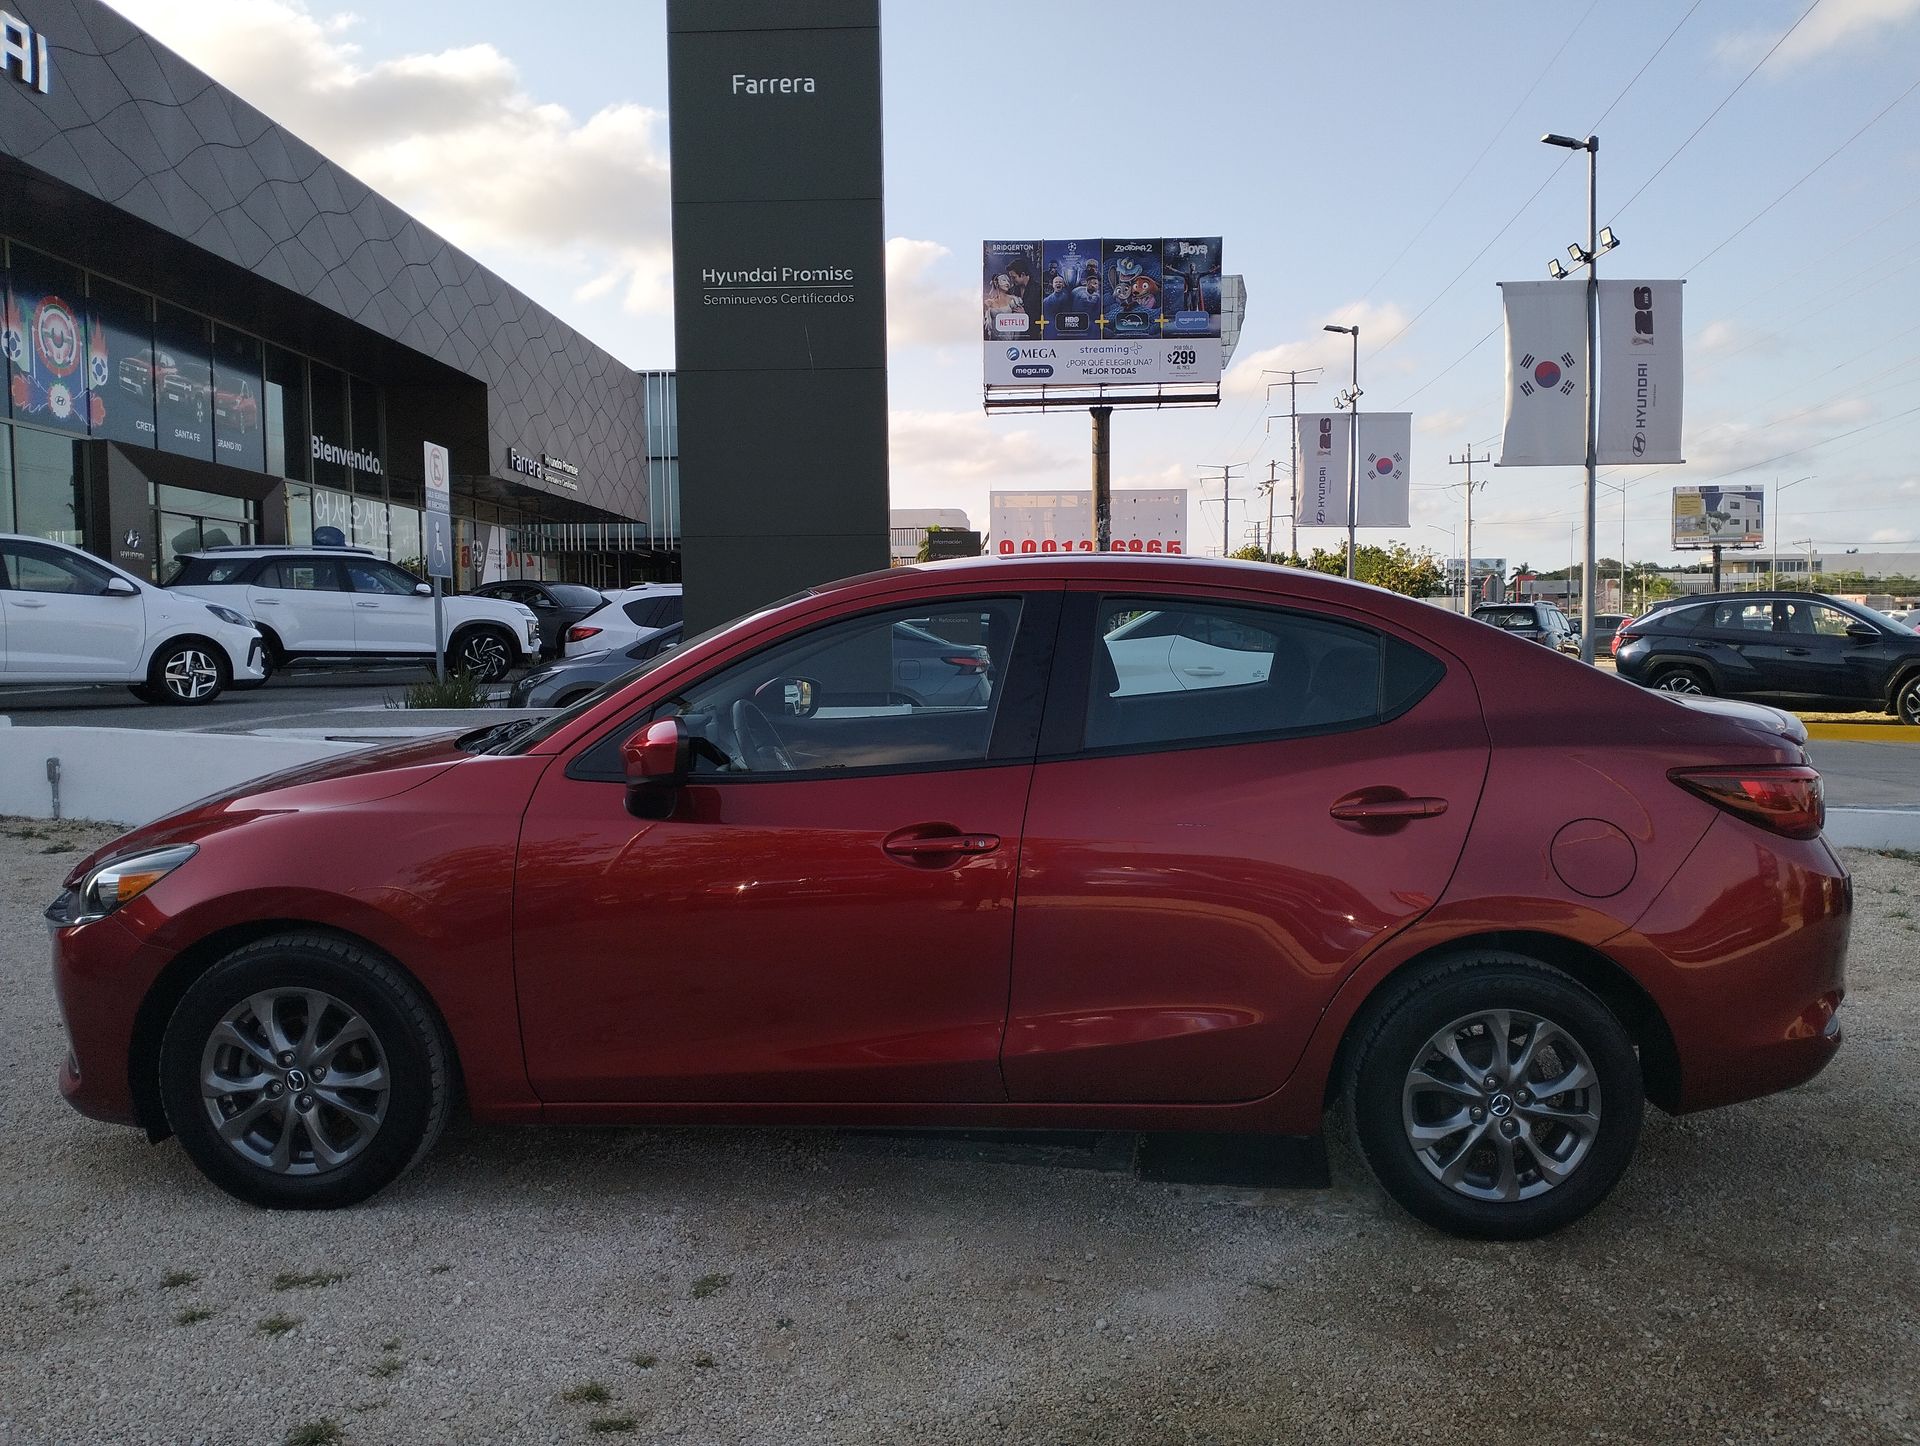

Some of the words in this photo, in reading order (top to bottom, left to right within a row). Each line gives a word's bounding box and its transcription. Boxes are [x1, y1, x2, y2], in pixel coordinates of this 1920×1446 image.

[732, 74, 815, 94] Farrera
[702, 267, 777, 286] Hyundai
[781, 265, 854, 283] Promise
[703, 293, 778, 306] Seminuevos
[780, 292, 855, 304] Certificados
[1000, 319, 1025, 327] NETFLIX
[1021, 348, 1057, 358] MEGA
[1080, 344, 1129, 355] streaming
[1066, 359, 1087, 368] ¿POR
[1088, 358, 1105, 367] QUÉ
[1106, 358, 1132, 366] ELEGIR
[1134, 357, 1153, 366] UNA?
[1167, 350, 1196, 364] $299
[1015, 367, 1050, 375] mega.mx
[1111, 367, 1137, 375] TODAS
[1635, 362, 1648, 429] HYUNDAI
[135, 420, 155, 433] CRETA
[174, 428, 193, 440] SANTA
[311, 434, 384, 476] Bienvenido.
[511, 447, 542, 479] Farrera
[1317, 466, 1327, 508] HYUNDAI
